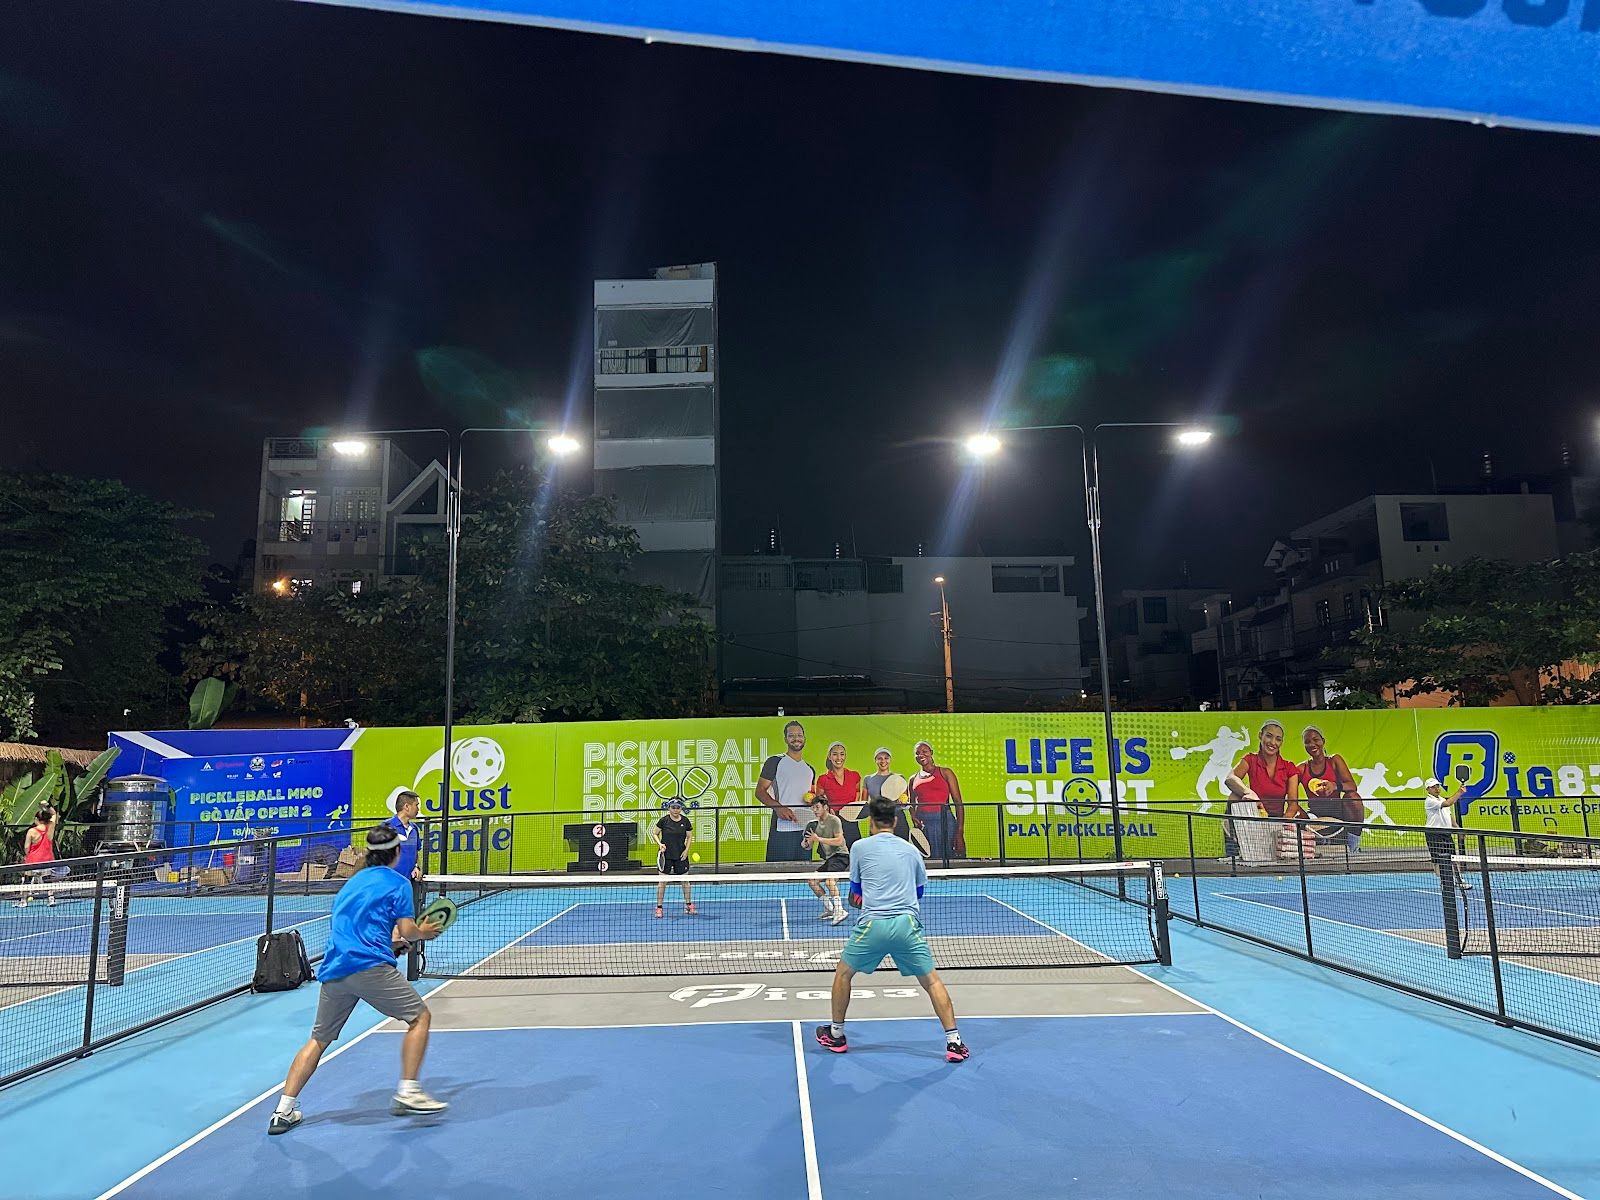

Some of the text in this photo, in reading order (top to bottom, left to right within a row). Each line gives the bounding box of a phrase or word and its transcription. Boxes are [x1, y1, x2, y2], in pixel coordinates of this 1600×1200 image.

[583, 737, 768, 768] PICKLEBALL
[1005, 737, 1151, 774] LIFE IS
[190, 786, 324, 805] PICKLEBALL MMO
[425, 782, 512, 812] Just
[1005, 778, 1155, 816] SHORT
[200, 803, 312, 822] GÒ VẤP OPEN 2
[1560, 805, 1569, 815] &
[1573, 804, 1600, 815] COF
[418, 822, 511, 853] ame
[596, 826, 604, 835] 2
[1008, 823, 1052, 837] PLAY
